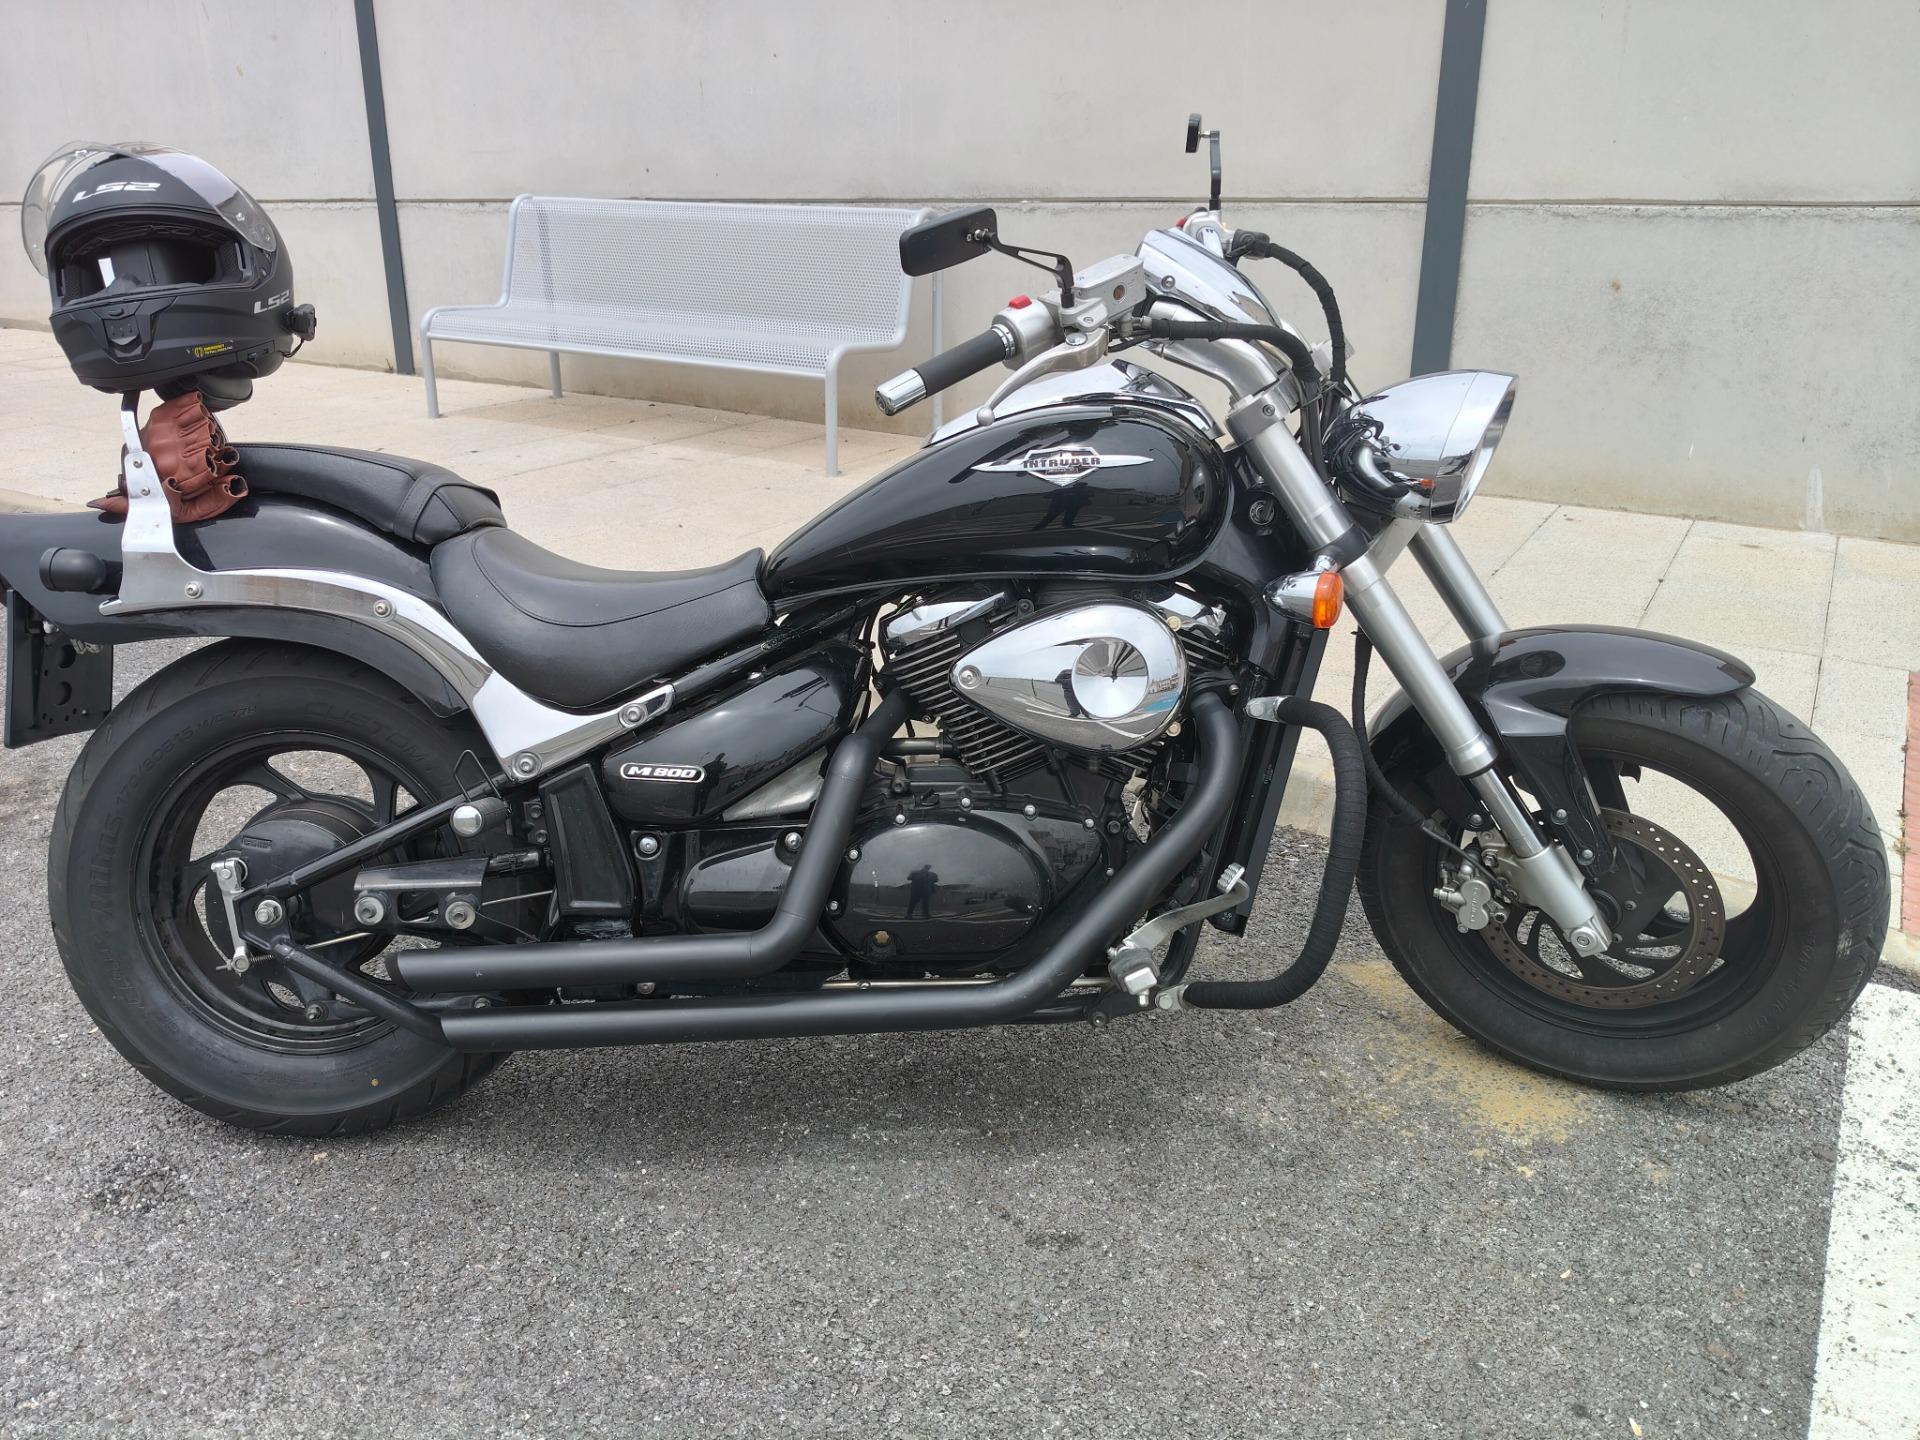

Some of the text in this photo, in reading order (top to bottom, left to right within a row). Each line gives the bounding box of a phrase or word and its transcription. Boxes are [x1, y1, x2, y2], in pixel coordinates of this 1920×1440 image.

[72, 181, 161, 203] LS2
[254, 290, 290, 315] LS2
[1023, 456, 1101, 469] INTRUDER
[627, 766, 697, 778] M 800
